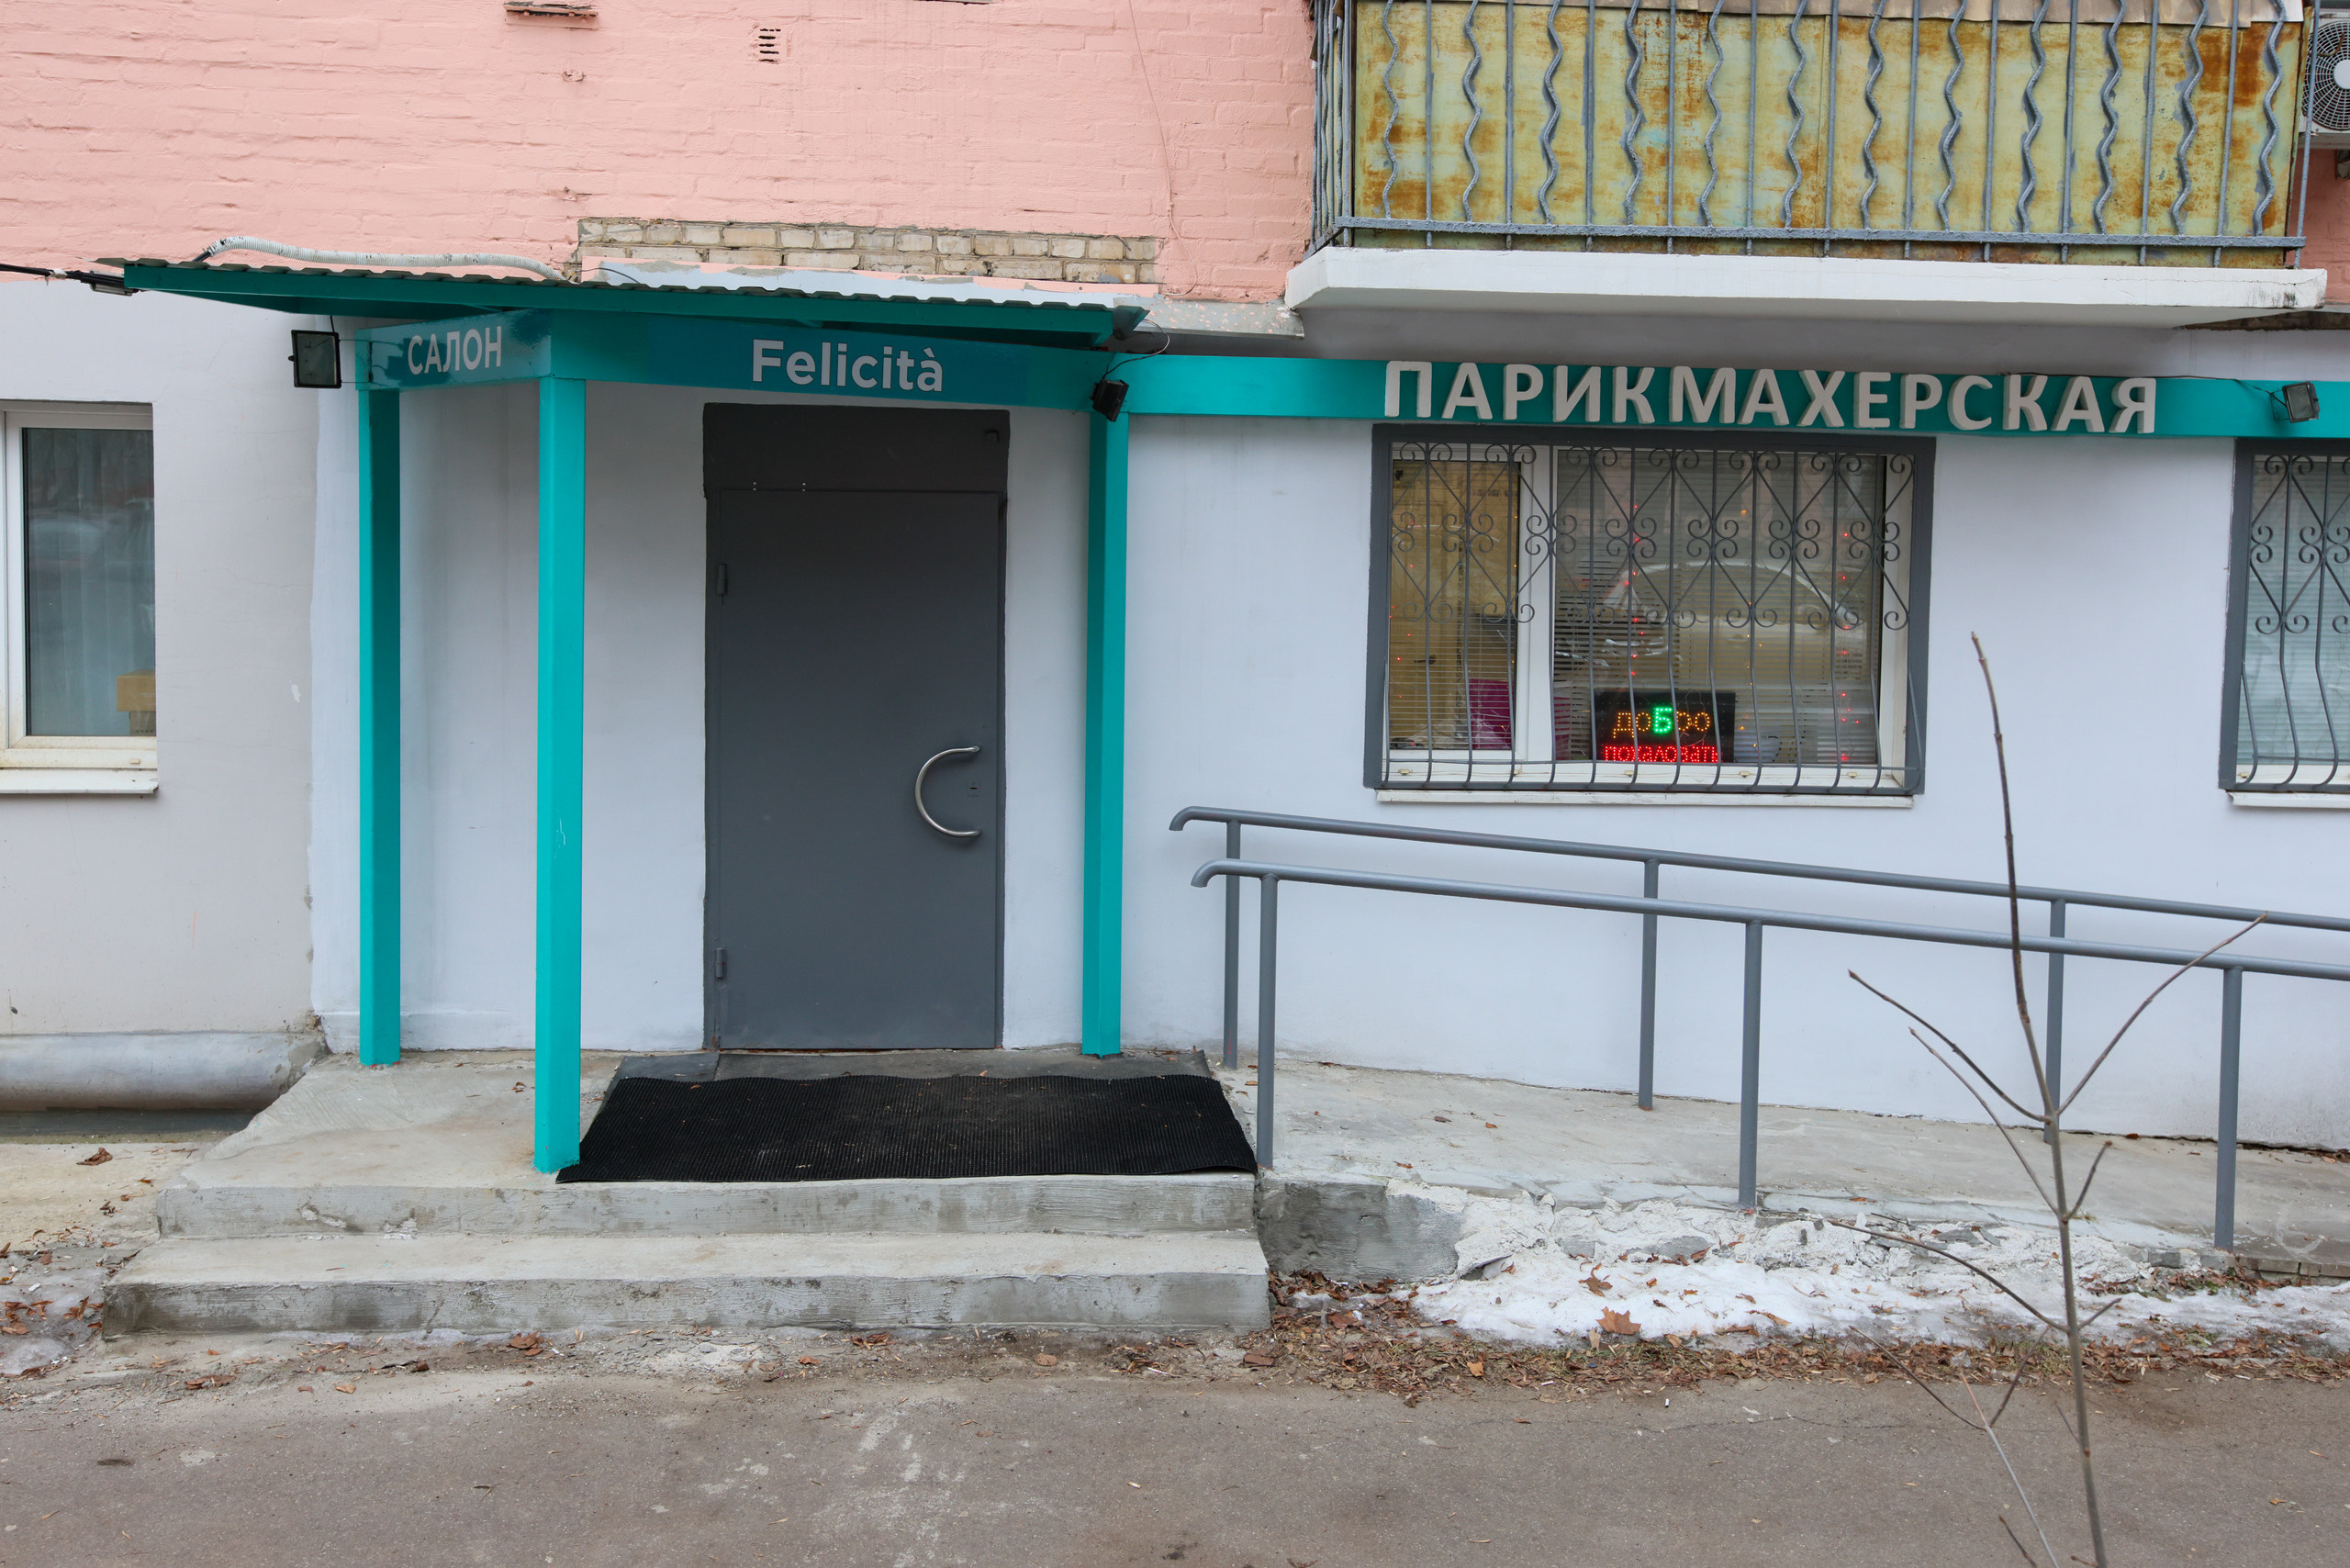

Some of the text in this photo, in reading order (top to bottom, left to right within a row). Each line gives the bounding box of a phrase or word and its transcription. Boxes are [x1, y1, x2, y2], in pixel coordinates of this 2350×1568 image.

[408, 325, 502, 375] САЛОН
[752, 338, 944, 392] Felicità
[1384, 360, 2157, 434] ПАРИКМАХЕРСКАЯ
